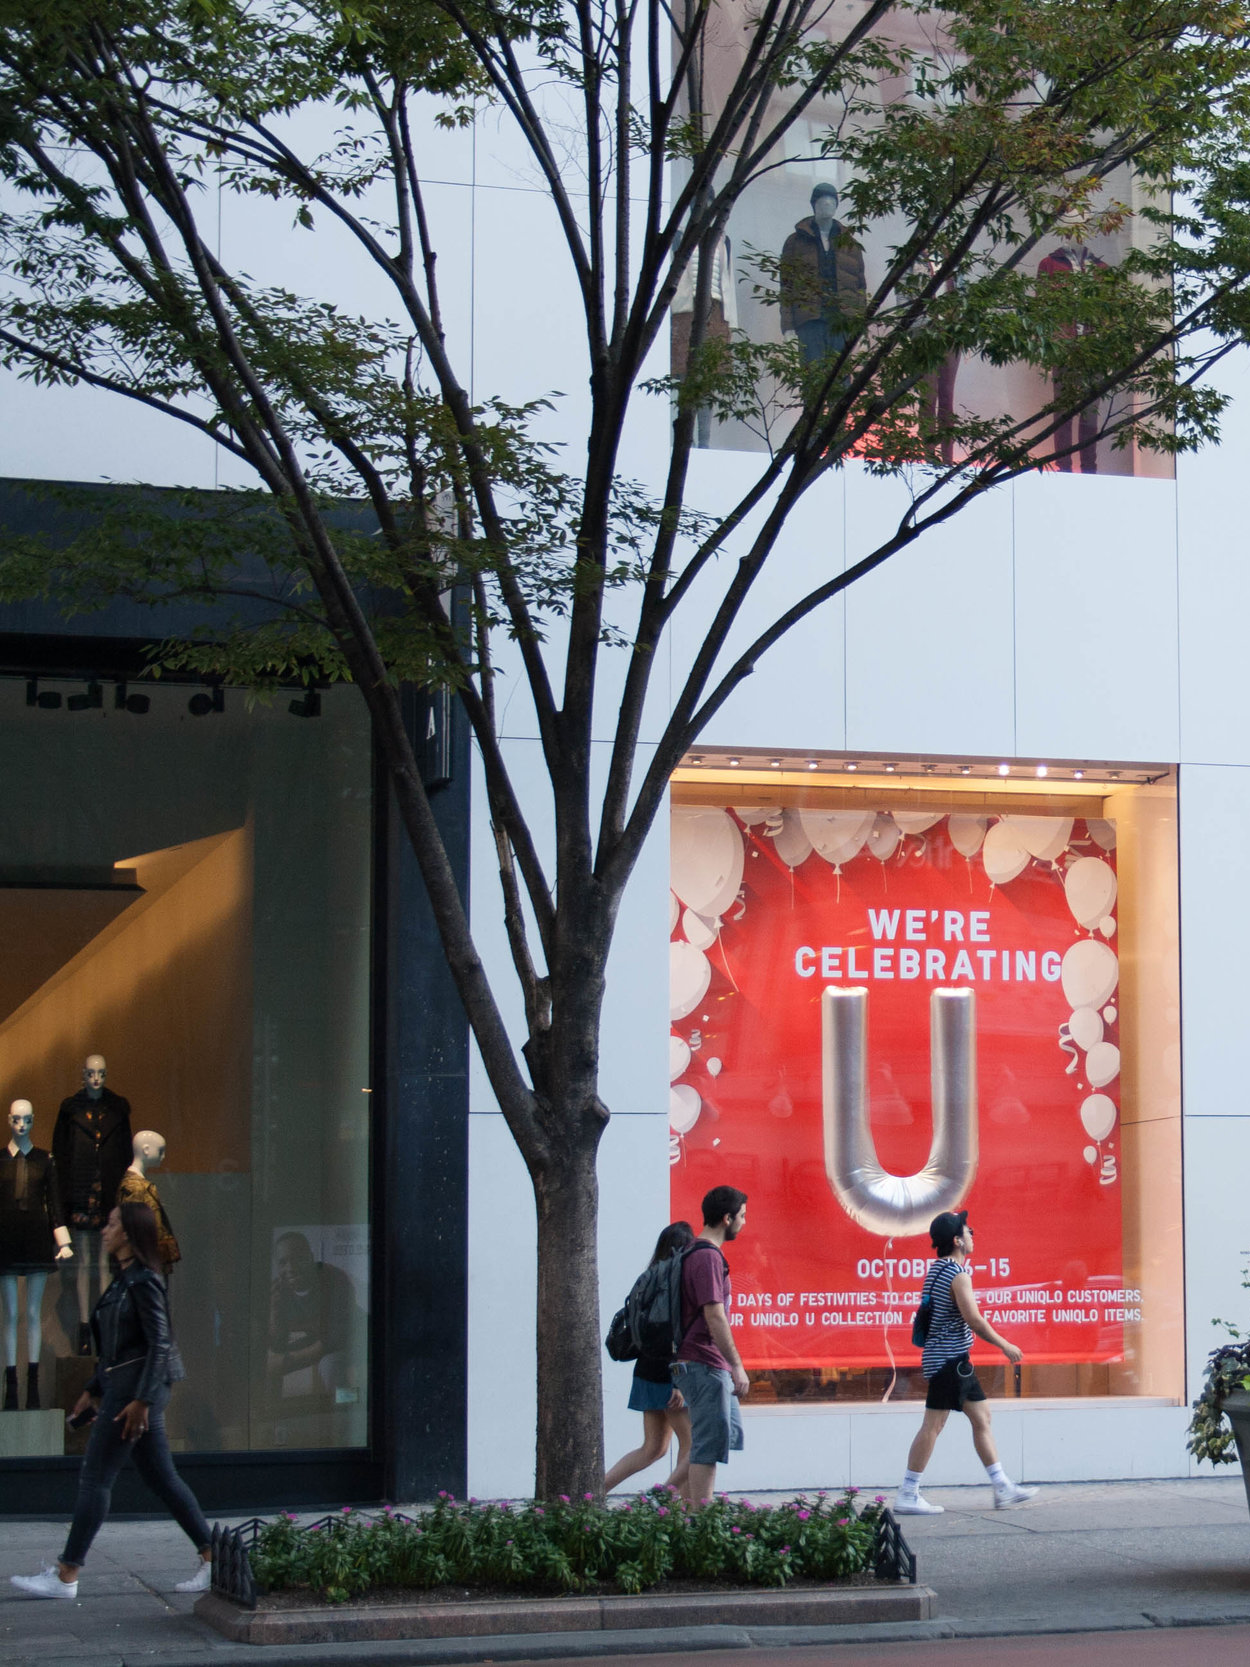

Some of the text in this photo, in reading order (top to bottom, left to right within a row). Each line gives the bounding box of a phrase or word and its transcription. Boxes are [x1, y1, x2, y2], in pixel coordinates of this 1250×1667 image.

[868, 908, 990, 942] WE'RE
[795, 946, 1062, 982] CELEBRATING
[821, 984, 979, 1238] U
[857, 1258, 937, 1278] OCTOB
[737, 1293, 772, 1306] DAYS
[777, 1293, 795, 1306] OF
[800, 1292, 877, 1306] FESTIVITIES
[882, 1292, 899, 1305] TO
[986, 1290, 1012, 1304] OUR
[1017, 1290, 1063, 1304] UNIQLO
[1067, 1289, 1144, 1303] CUSTOMERS.
[751, 1313, 799, 1327] UNIQLO
[805, 1312, 815, 1325] U
[821, 1312, 903, 1325] COLLECTION
[984, 1309, 1046, 1323] FAVORITE
[1052, 1309, 1098, 1323] UNIQLO
[1104, 1308, 1144, 1322] ITEMS.
